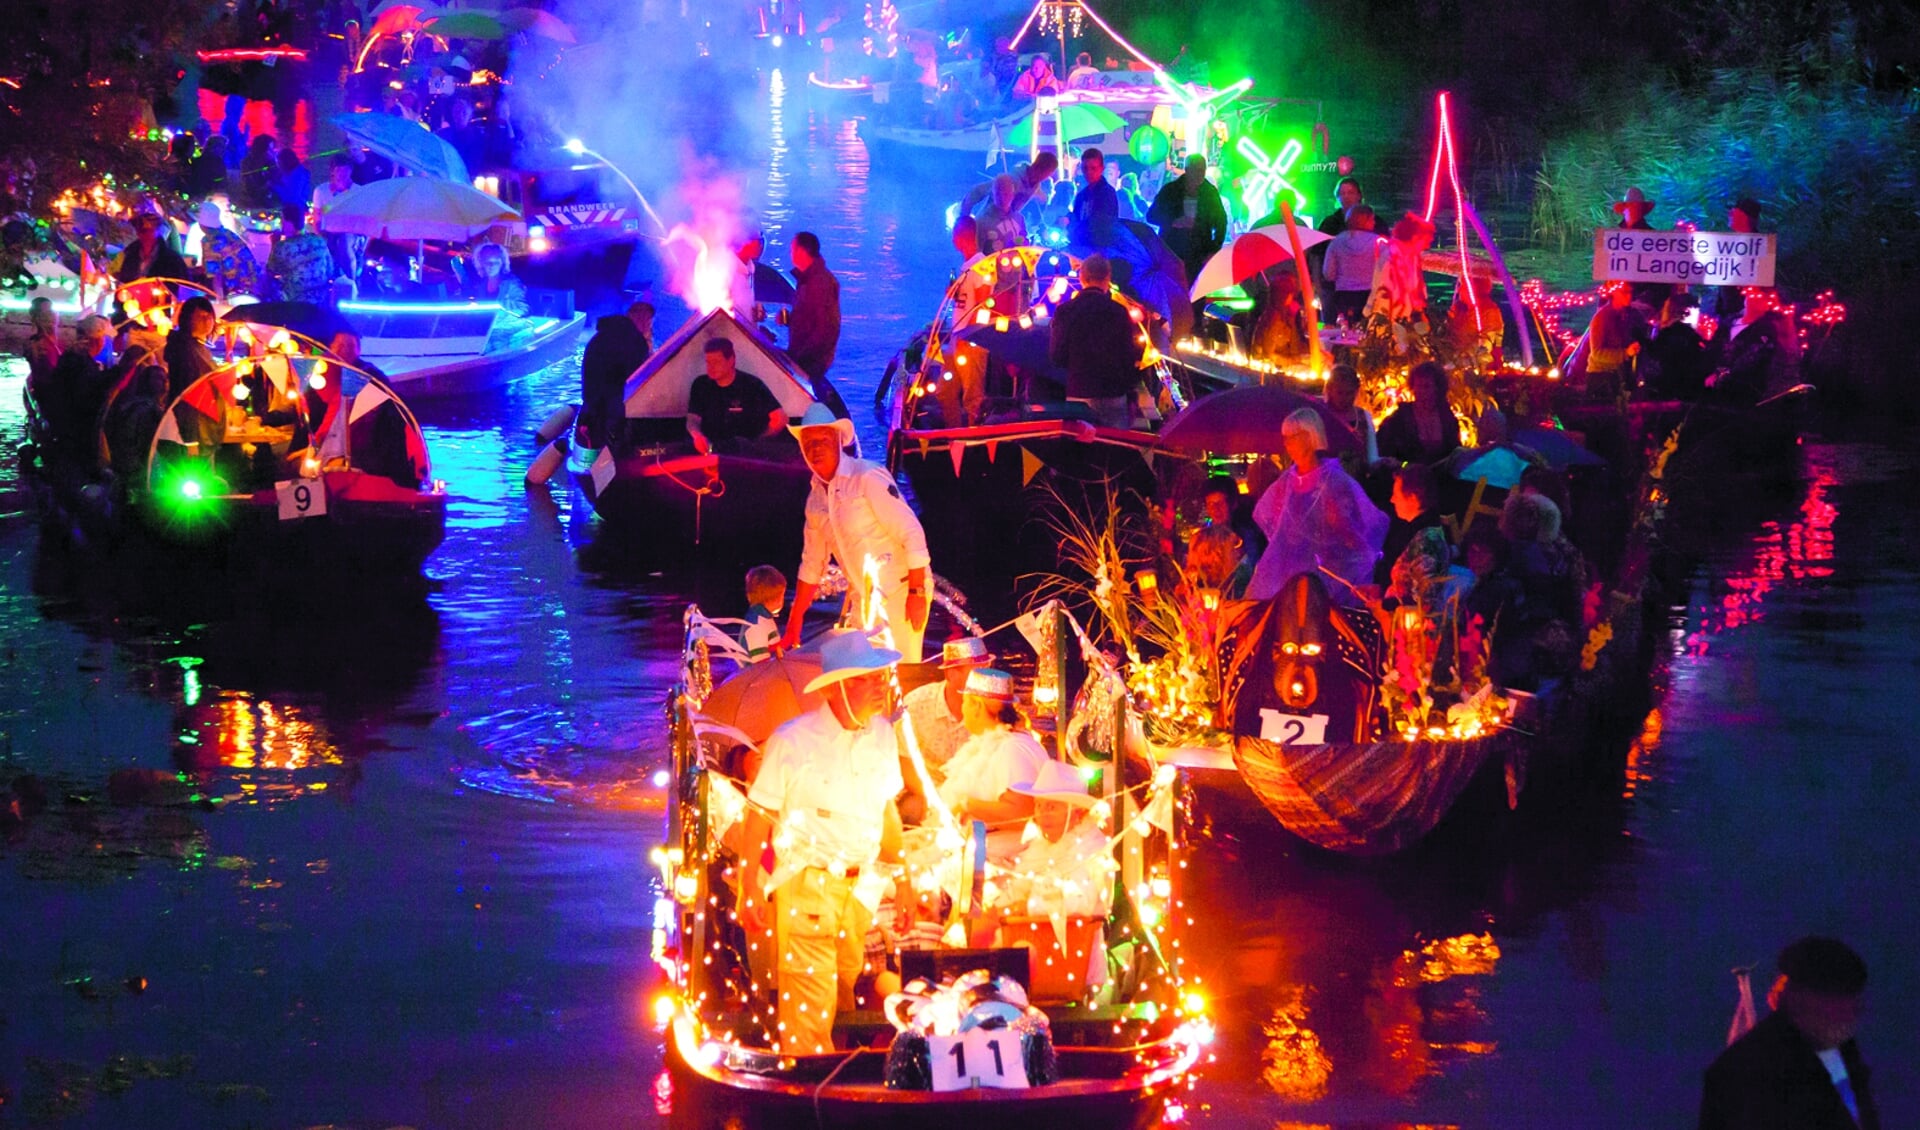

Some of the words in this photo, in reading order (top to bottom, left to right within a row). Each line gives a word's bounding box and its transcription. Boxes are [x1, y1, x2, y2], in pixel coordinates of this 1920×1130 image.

[548, 202, 616, 214] BRANDWEER
[1607, 233, 1633, 251] de
[1641, 235, 1709, 254] eerste
[1717, 238, 1763, 256] wolf
[1610, 252, 1629, 271] in
[1636, 254, 1742, 280] Langedijk
[1750, 259, 1756, 277] !
[294, 484, 312, 512] 9
[1283, 719, 1305, 746] 2
[948, 1039, 1005, 1078] 11
